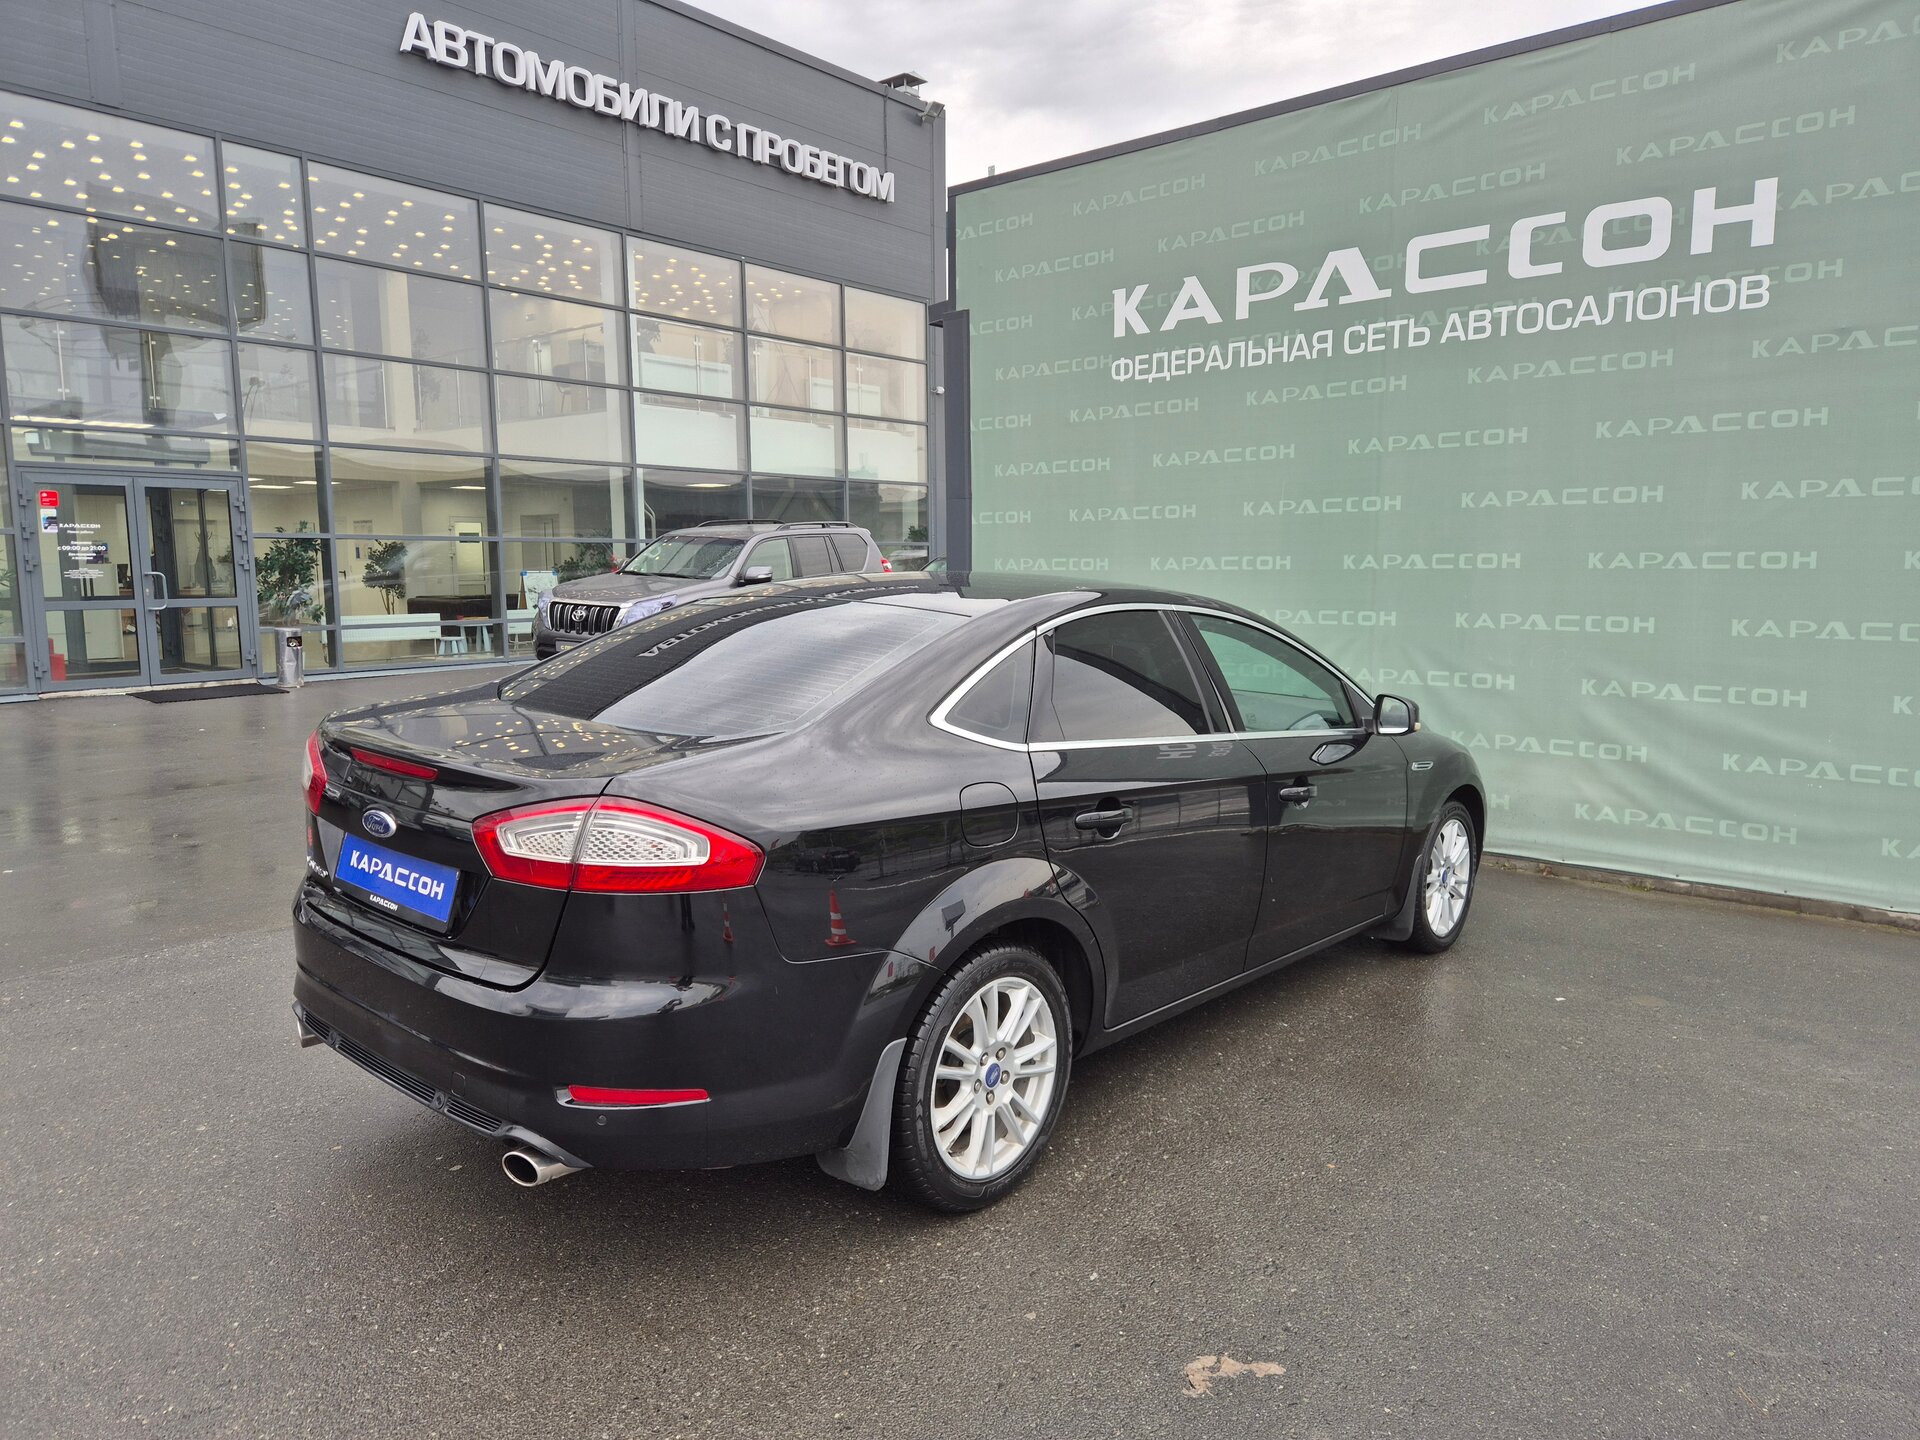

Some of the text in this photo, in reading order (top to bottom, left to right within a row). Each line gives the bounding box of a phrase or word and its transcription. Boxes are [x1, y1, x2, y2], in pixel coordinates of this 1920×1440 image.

[1776, 15, 1920, 64] КАРА
[400, 12, 895, 202] АВТОМОБИЛИ С ПРОБЕГОМ
[1483, 62, 1697, 125] КАРАССОН
[1254, 123, 1422, 177] КАРАССОН
[1616, 105, 1856, 166] КАРАССОН
[1073, 174, 1205, 216] КАРАССОН
[1359, 162, 1546, 214] КАРАССОН
[1157, 210, 1305, 253] КАРАССОН
[994, 248, 1114, 284] КАРАССОН
[1112, 177, 1778, 338] КАРАССОН
[1111, 274, 1770, 383] ФЕДЕРАЛЬНАЯ СЕТЬ АВТОСАЛОНОВ
[1751, 325, 1920, 359] КАРАС
[995, 355, 1112, 381] КАРАССОН
[1467, 349, 1674, 384] КАРАССОН
[1246, 375, 1407, 406] КАРАССОН
[1069, 397, 1199, 423] КАРАССОН
[1596, 407, 1829, 439] КАРАССОН
[1347, 426, 1528, 455] КАРАССОН
[995, 457, 1111, 477] КАРАССОН
[1152, 444, 1295, 469] КАРАССОН
[1243, 496, 1402, 517] КАРАССОН
[1461, 485, 1664, 509] КАРАССОН
[1069, 504, 1197, 523] КАРАССОН
[994, 557, 1109, 572] КАРАССОН
[1150, 555, 1291, 571] КАРАССОН
[1343, 552, 1521, 570] КАРАССОН
[1588, 551, 1818, 570] КАРАССОН
[1455, 612, 1655, 634] КАРАССОН
[1731, 618, 1920, 642] КАРАСС
[1581, 678, 1808, 709] КАРАССОН
[1722, 753, 1920, 788] КАРАСС
[1574, 802, 1798, 845] КАРАССОН
[350, 849, 445, 900] КАРАССОН
[369, 894, 399, 911] КАРАССОН
